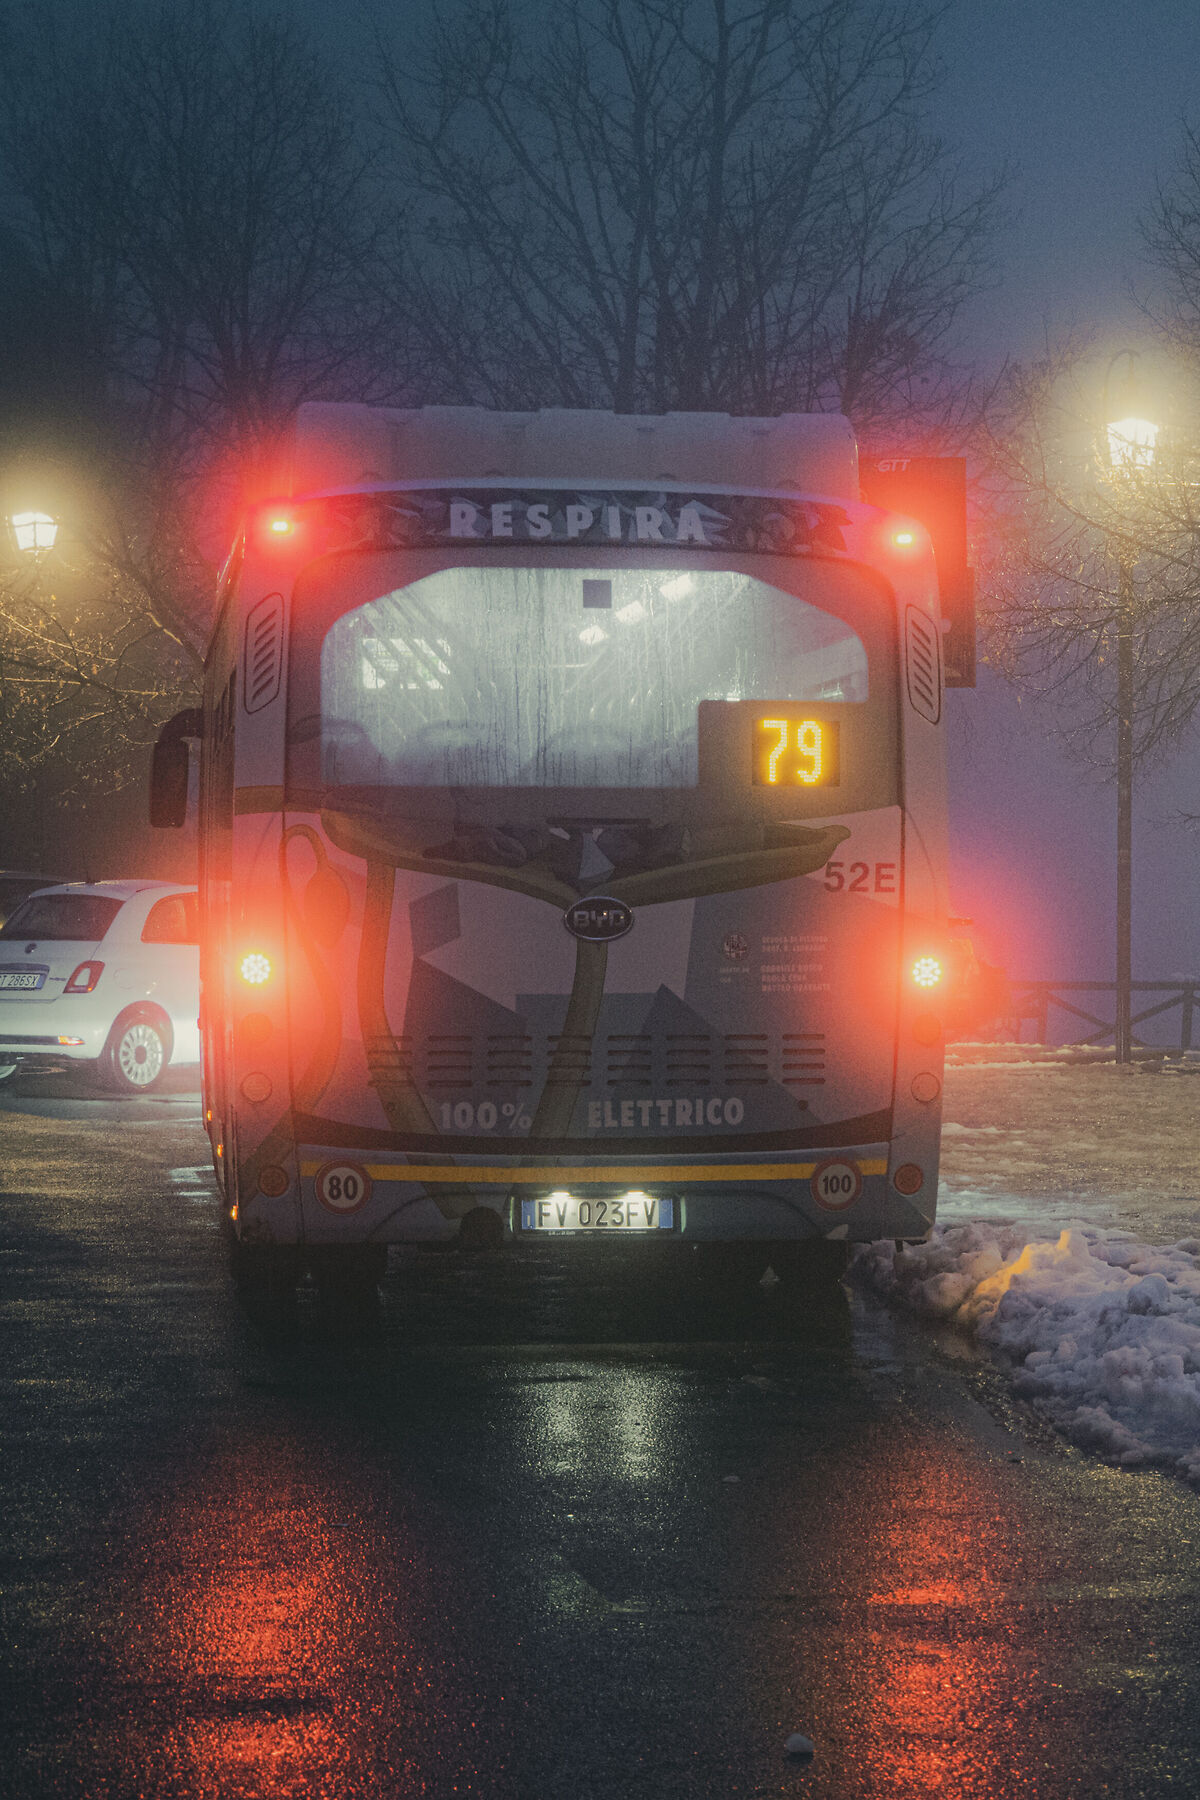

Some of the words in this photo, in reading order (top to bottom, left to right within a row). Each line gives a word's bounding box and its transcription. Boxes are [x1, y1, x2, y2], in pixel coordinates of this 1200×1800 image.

[877, 459, 911, 472] GTT
[449, 499, 705, 541] RESPIRA
[763, 719, 823, 783] 79
[823, 861, 896, 894] 52E
[439, 1101, 533, 1131] 100%
[587, 1097, 745, 1129] ELETTRICO
[328, 1175, 358, 1200] 80
[822, 1174, 851, 1195] 100
[538, 1201, 567, 1227] FV
[578, 1201, 657, 1227] 023FV
